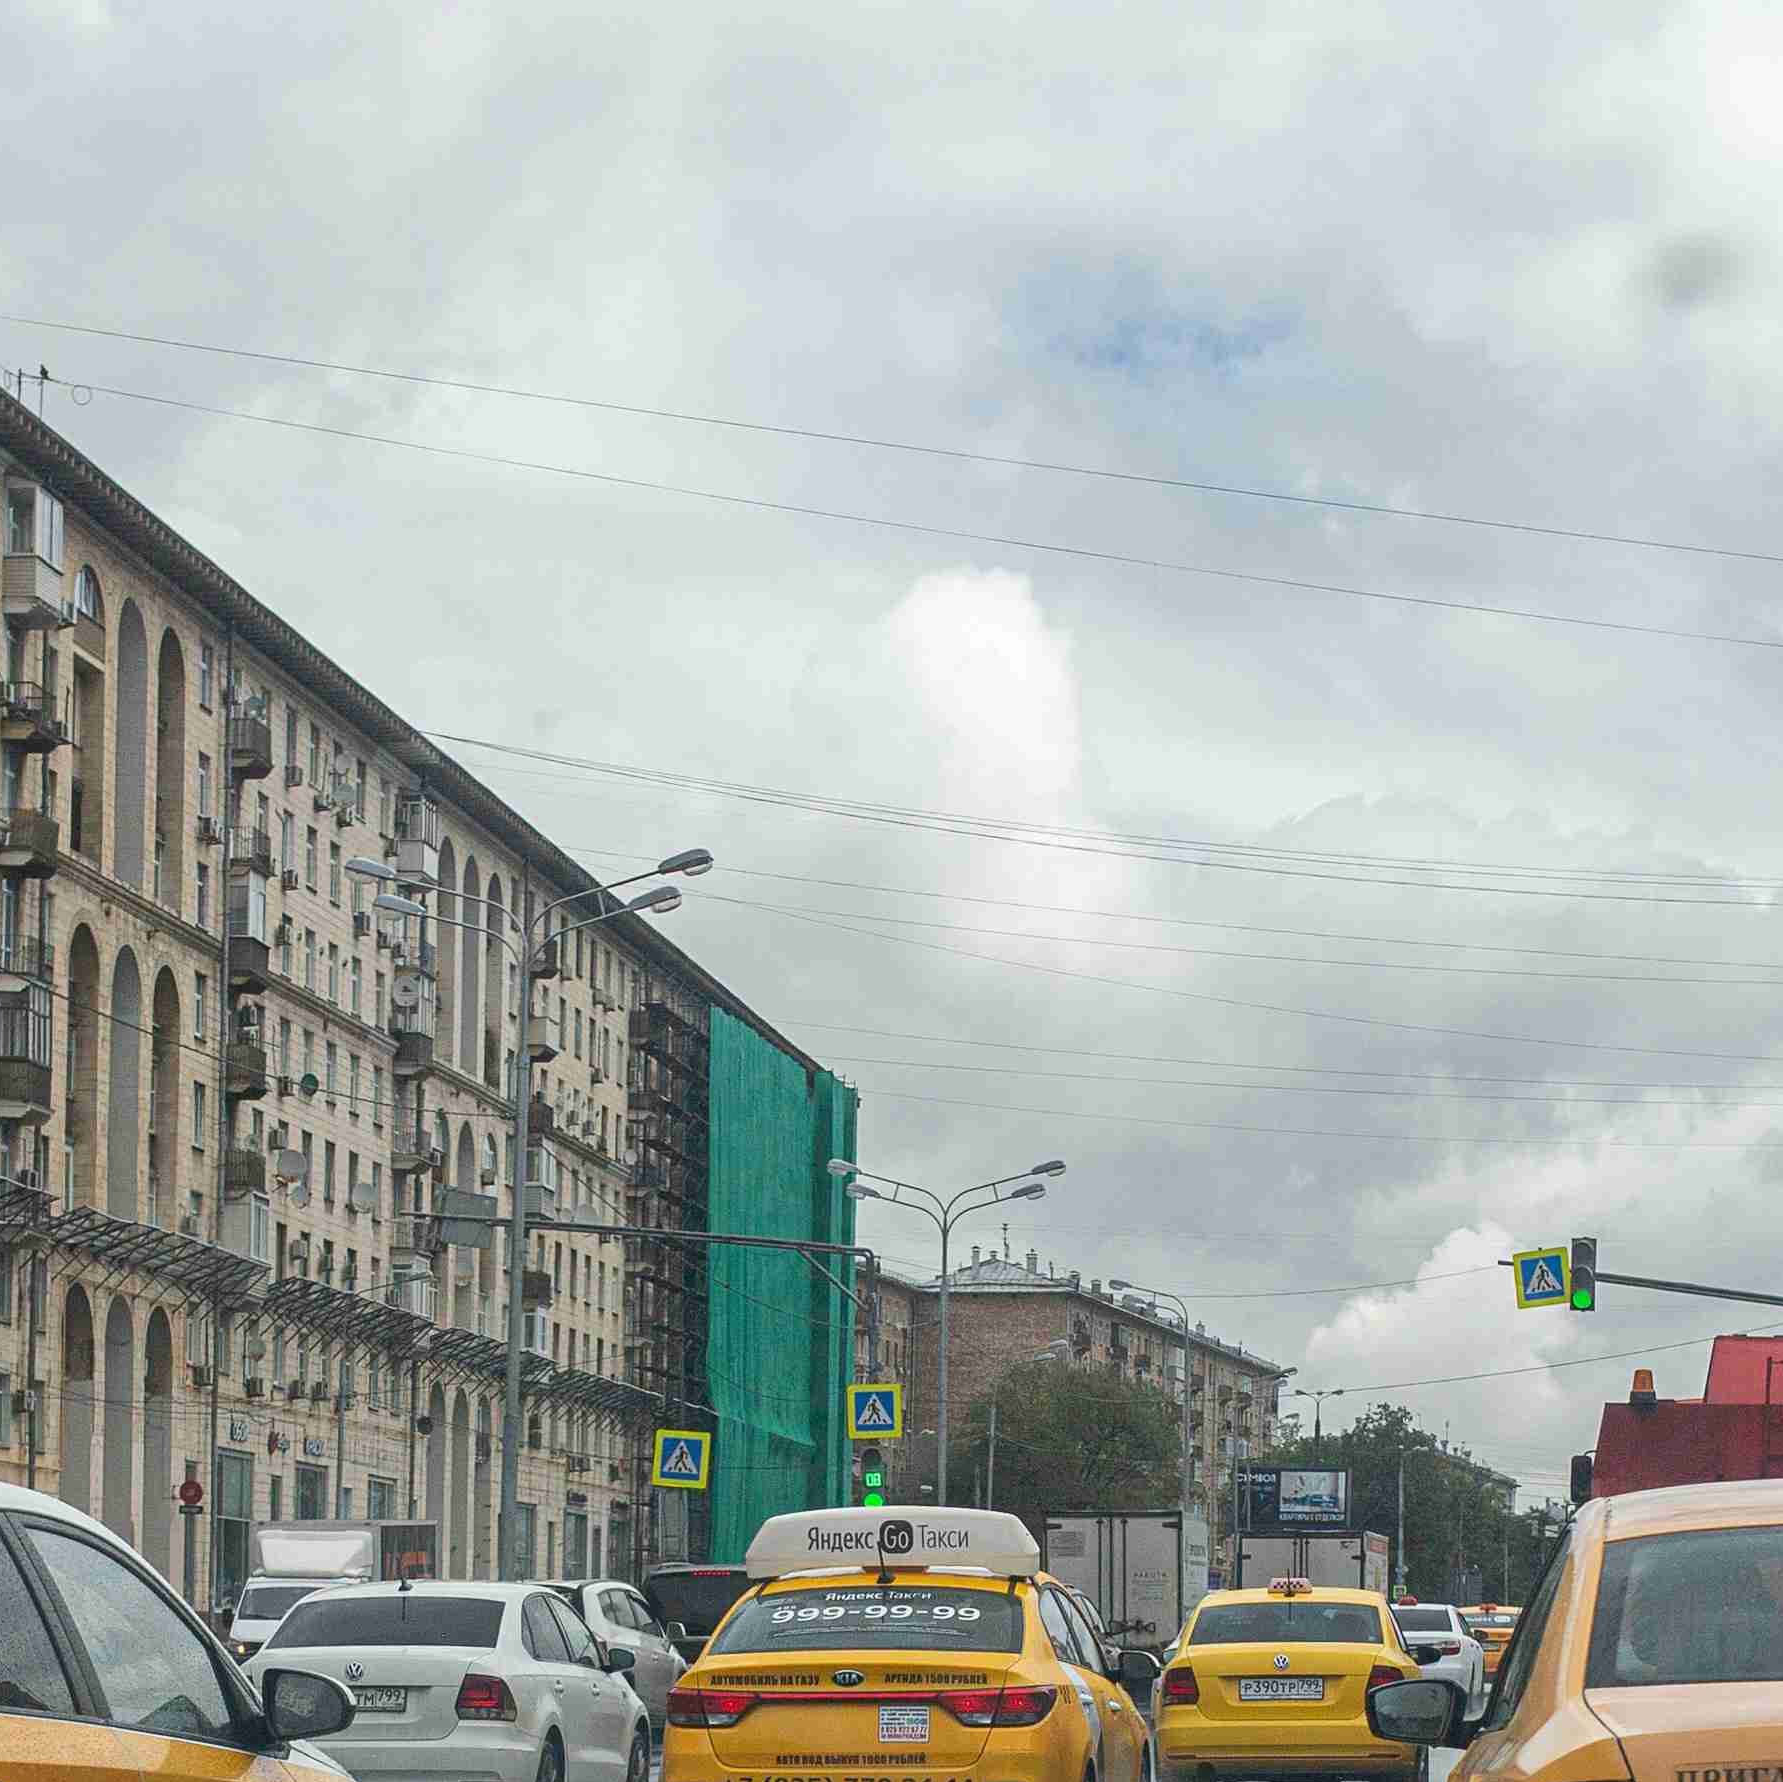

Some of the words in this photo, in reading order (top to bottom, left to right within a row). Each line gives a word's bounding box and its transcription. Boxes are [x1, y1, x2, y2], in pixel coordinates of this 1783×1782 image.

[807, 1526, 874, 1553] Яндекс
[883, 1524, 910, 1549] Go
[916, 1524, 969, 1549] Такси
[824, 1591, 884, 1602] Яндекс
[888, 1591, 933, 1601] Такси
[771, 1604, 982, 1624] 999-99-99
[710, 1675, 779, 1686] АВТОМОБИЛЬ
[834, 1672, 861, 1685] KIA
[884, 1673, 923, 1685] АРЕНДА
[951, 1672, 988, 1685] РУБЛЕЙ
[1244, 1680, 1296, 1694] Р390ТР
[1299, 1679, 1319, 1689] 799
